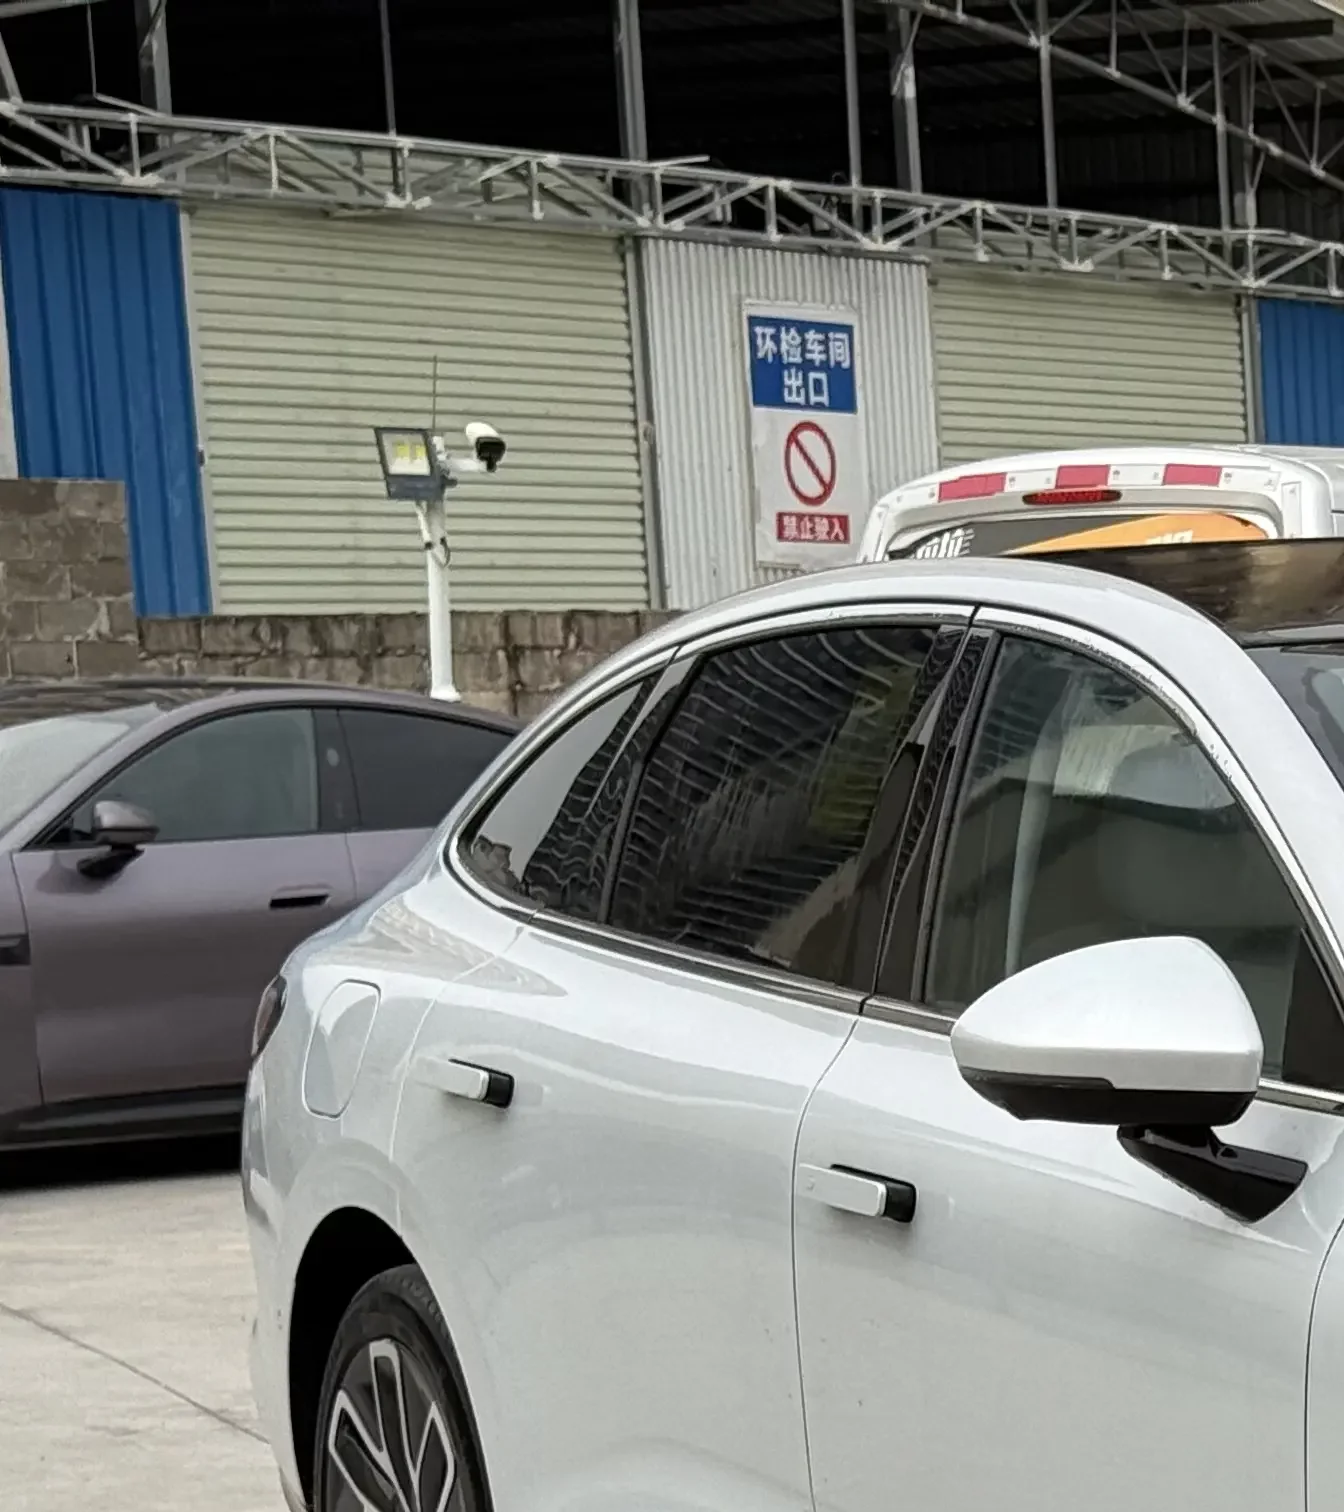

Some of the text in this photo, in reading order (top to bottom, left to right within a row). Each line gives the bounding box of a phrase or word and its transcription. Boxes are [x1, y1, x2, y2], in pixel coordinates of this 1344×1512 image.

[754, 326, 850, 369] 环检车间
[783, 371, 829, 407] 出口
